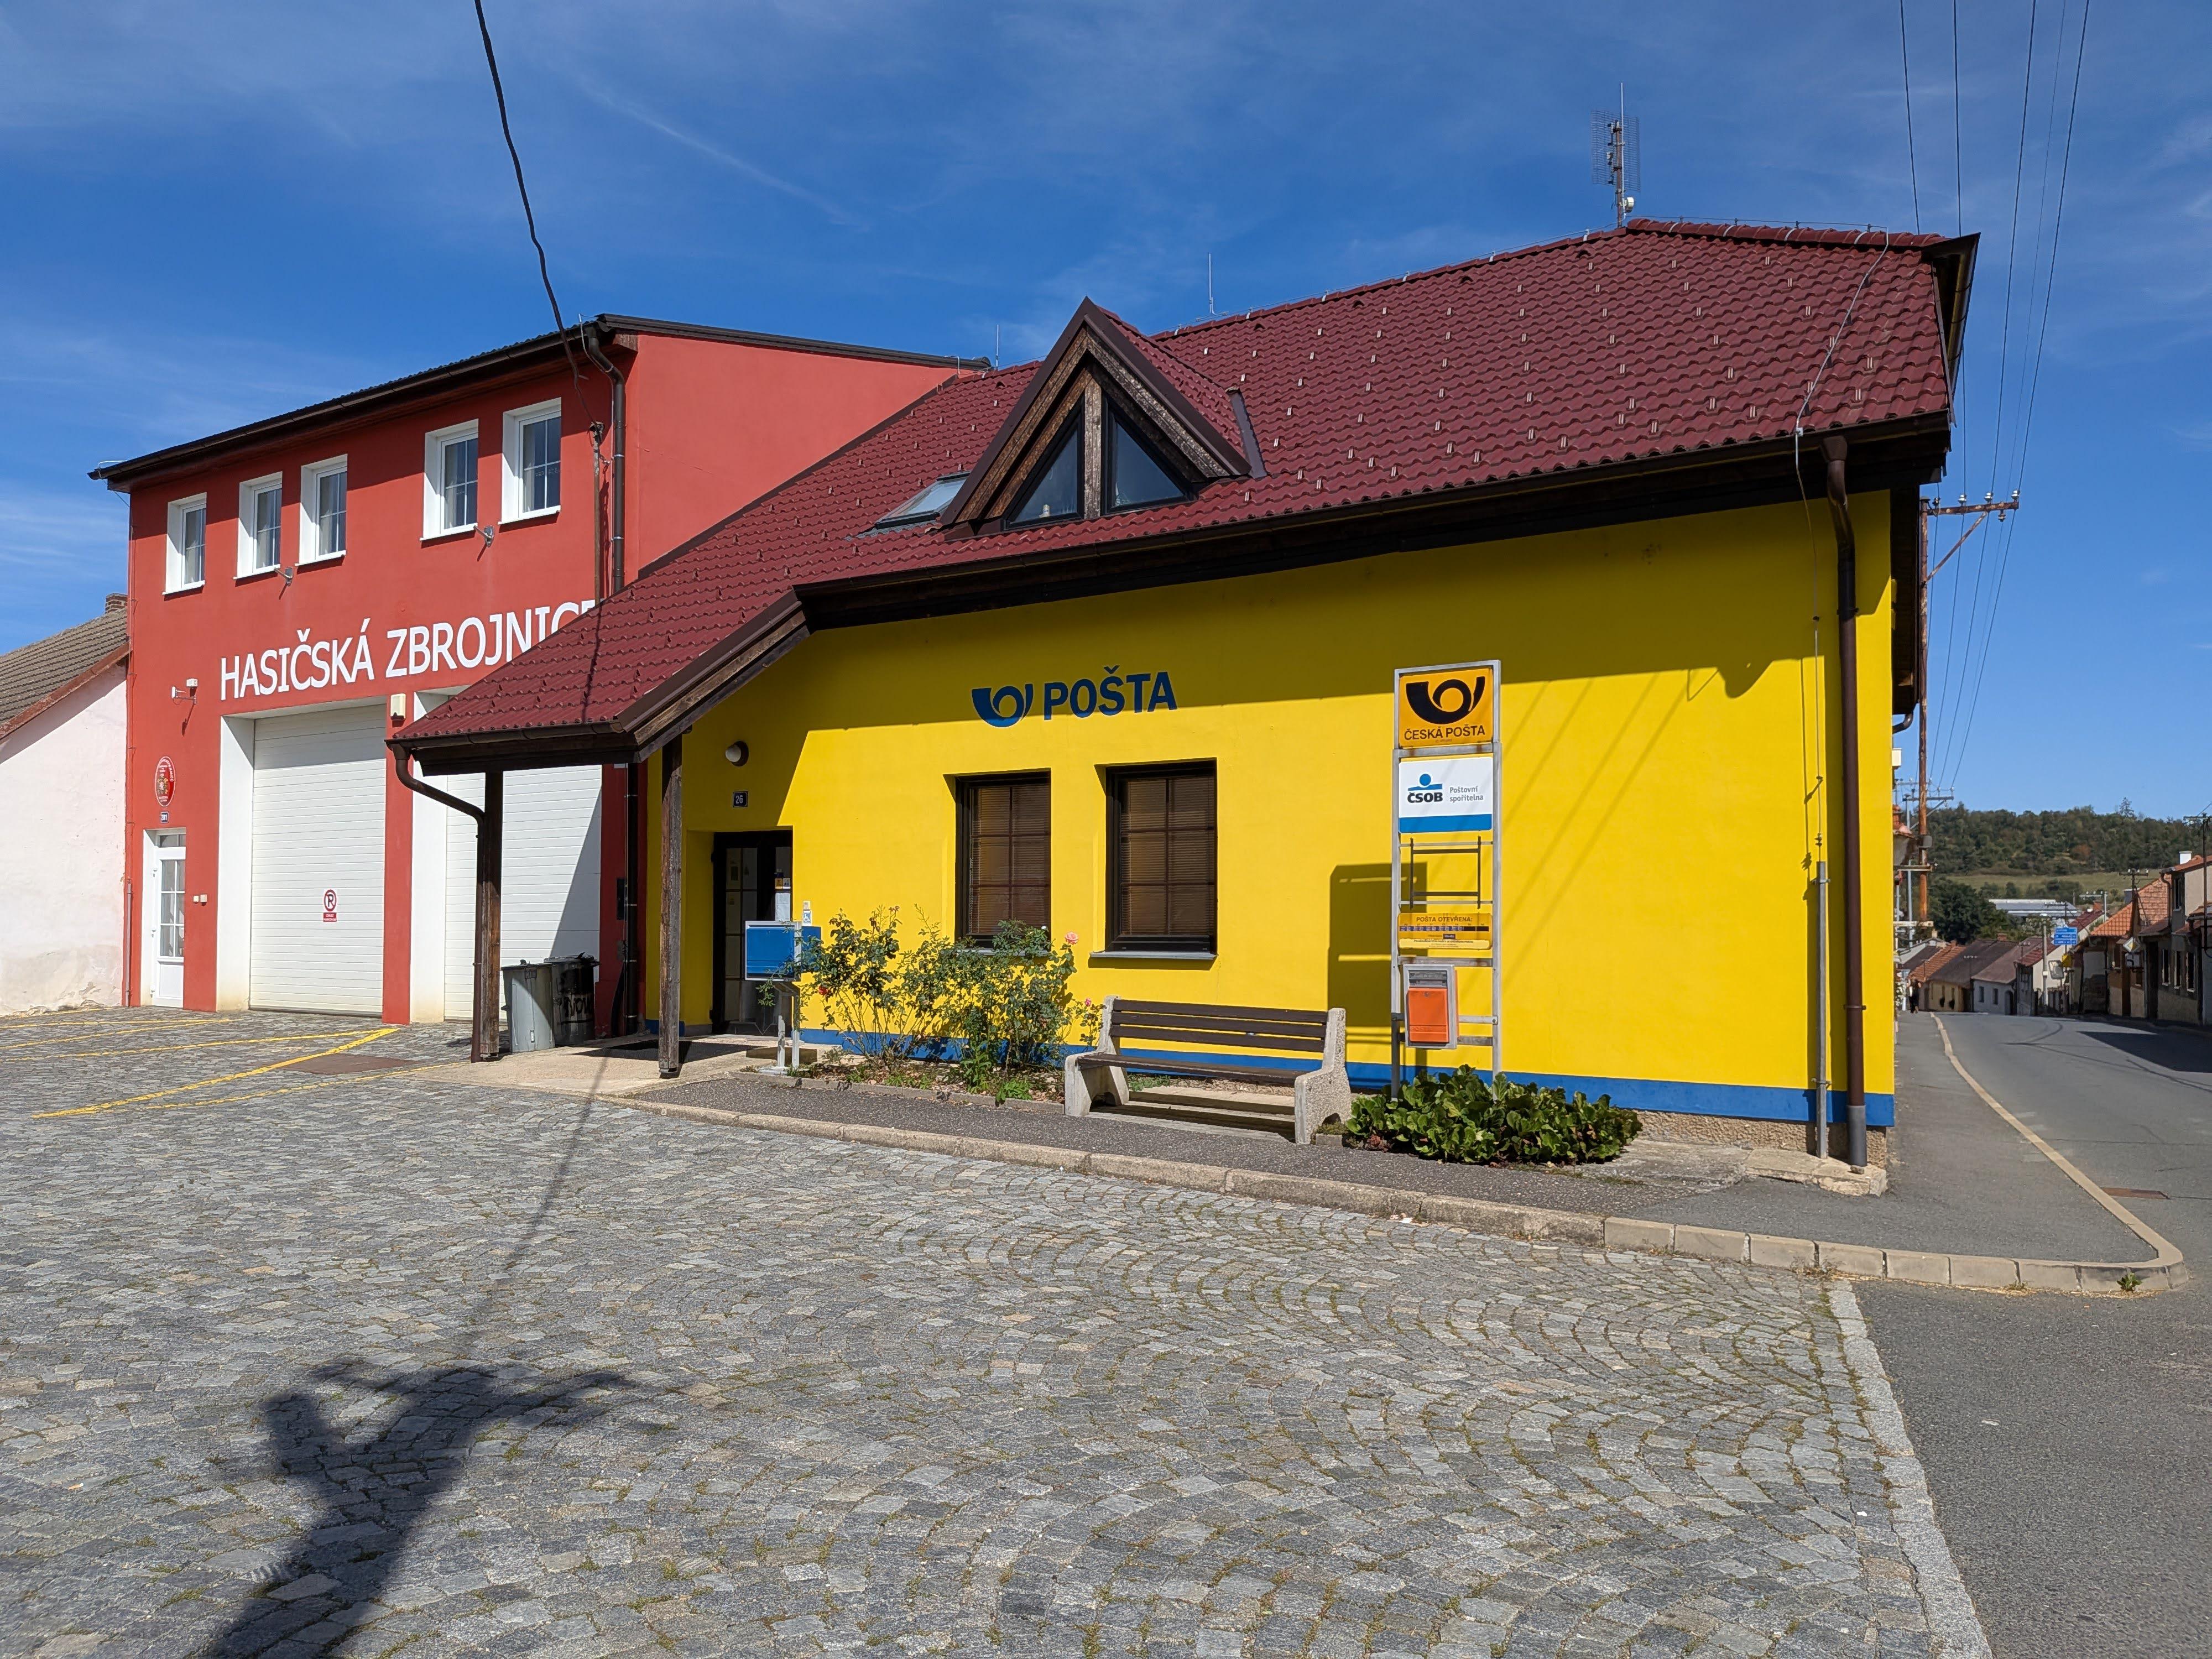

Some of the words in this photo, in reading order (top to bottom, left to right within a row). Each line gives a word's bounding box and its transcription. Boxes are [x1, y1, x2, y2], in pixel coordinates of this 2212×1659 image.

[221, 618, 374, 700] HASIČSKÁ
[385, 599, 606, 678] ZBROJNIC
[1044, 665, 1178, 721] POŠTA
[1404, 726, 1443, 740] ČESKÁ
[1446, 724, 1485, 738] POŠTA
[735, 795, 743, 804] 26
[1407, 791, 1443, 803] ČSOB
[1449, 794, 1484, 803] spořitelna
